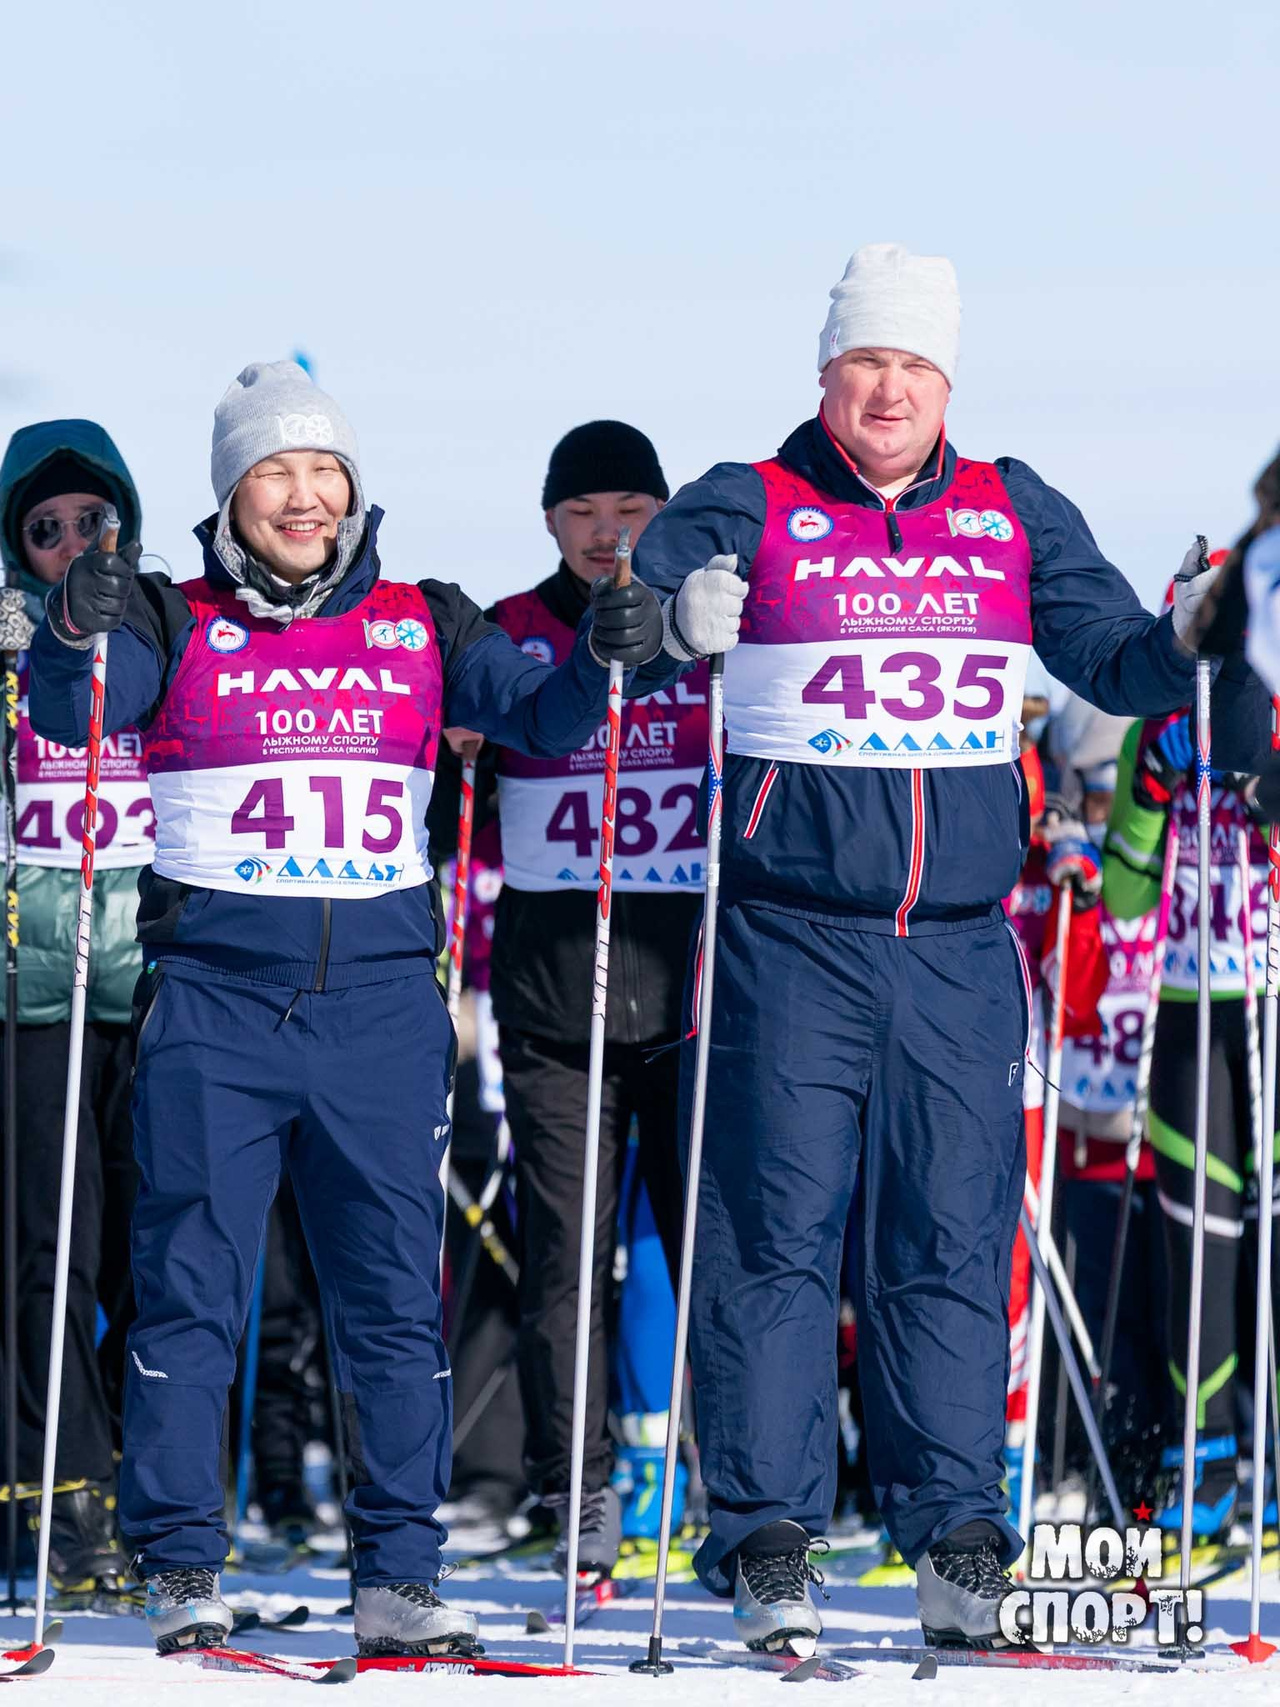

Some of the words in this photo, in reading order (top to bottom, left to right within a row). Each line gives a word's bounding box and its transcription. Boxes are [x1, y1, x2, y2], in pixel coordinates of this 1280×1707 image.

[794, 555, 1006, 581] HAVAL
[833, 593, 901, 616] 100
[916, 592, 980, 615] ЛЕТ
[840, 616, 918, 627] ЛЫЖНОМУ
[920, 616, 976, 627] СПОРТУ
[848, 626, 907, 634] РЕСПУБЛИКЕ
[907, 625, 934, 633] САХА
[936, 626, 977, 634] (ЯКУТИЯ)
[217, 667, 411, 696] HAVAL
[801, 651, 1009, 721] 435
[255, 708, 316, 735] 100
[328, 708, 384, 734] ЛЕТ
[263, 736, 330, 747] ЛЫЖНОМУ
[332, 736, 380, 747] СПОРТУ
[627, 722, 677, 748] ЛЕТ
[269, 746, 320, 755] РЕСПУБЛИКЕ
[321, 746, 345, 754] САХА
[346, 746, 379, 756] (ЯКУТИЯ)
[231, 776, 404, 854] 415
[546, 784, 707, 858] 482
